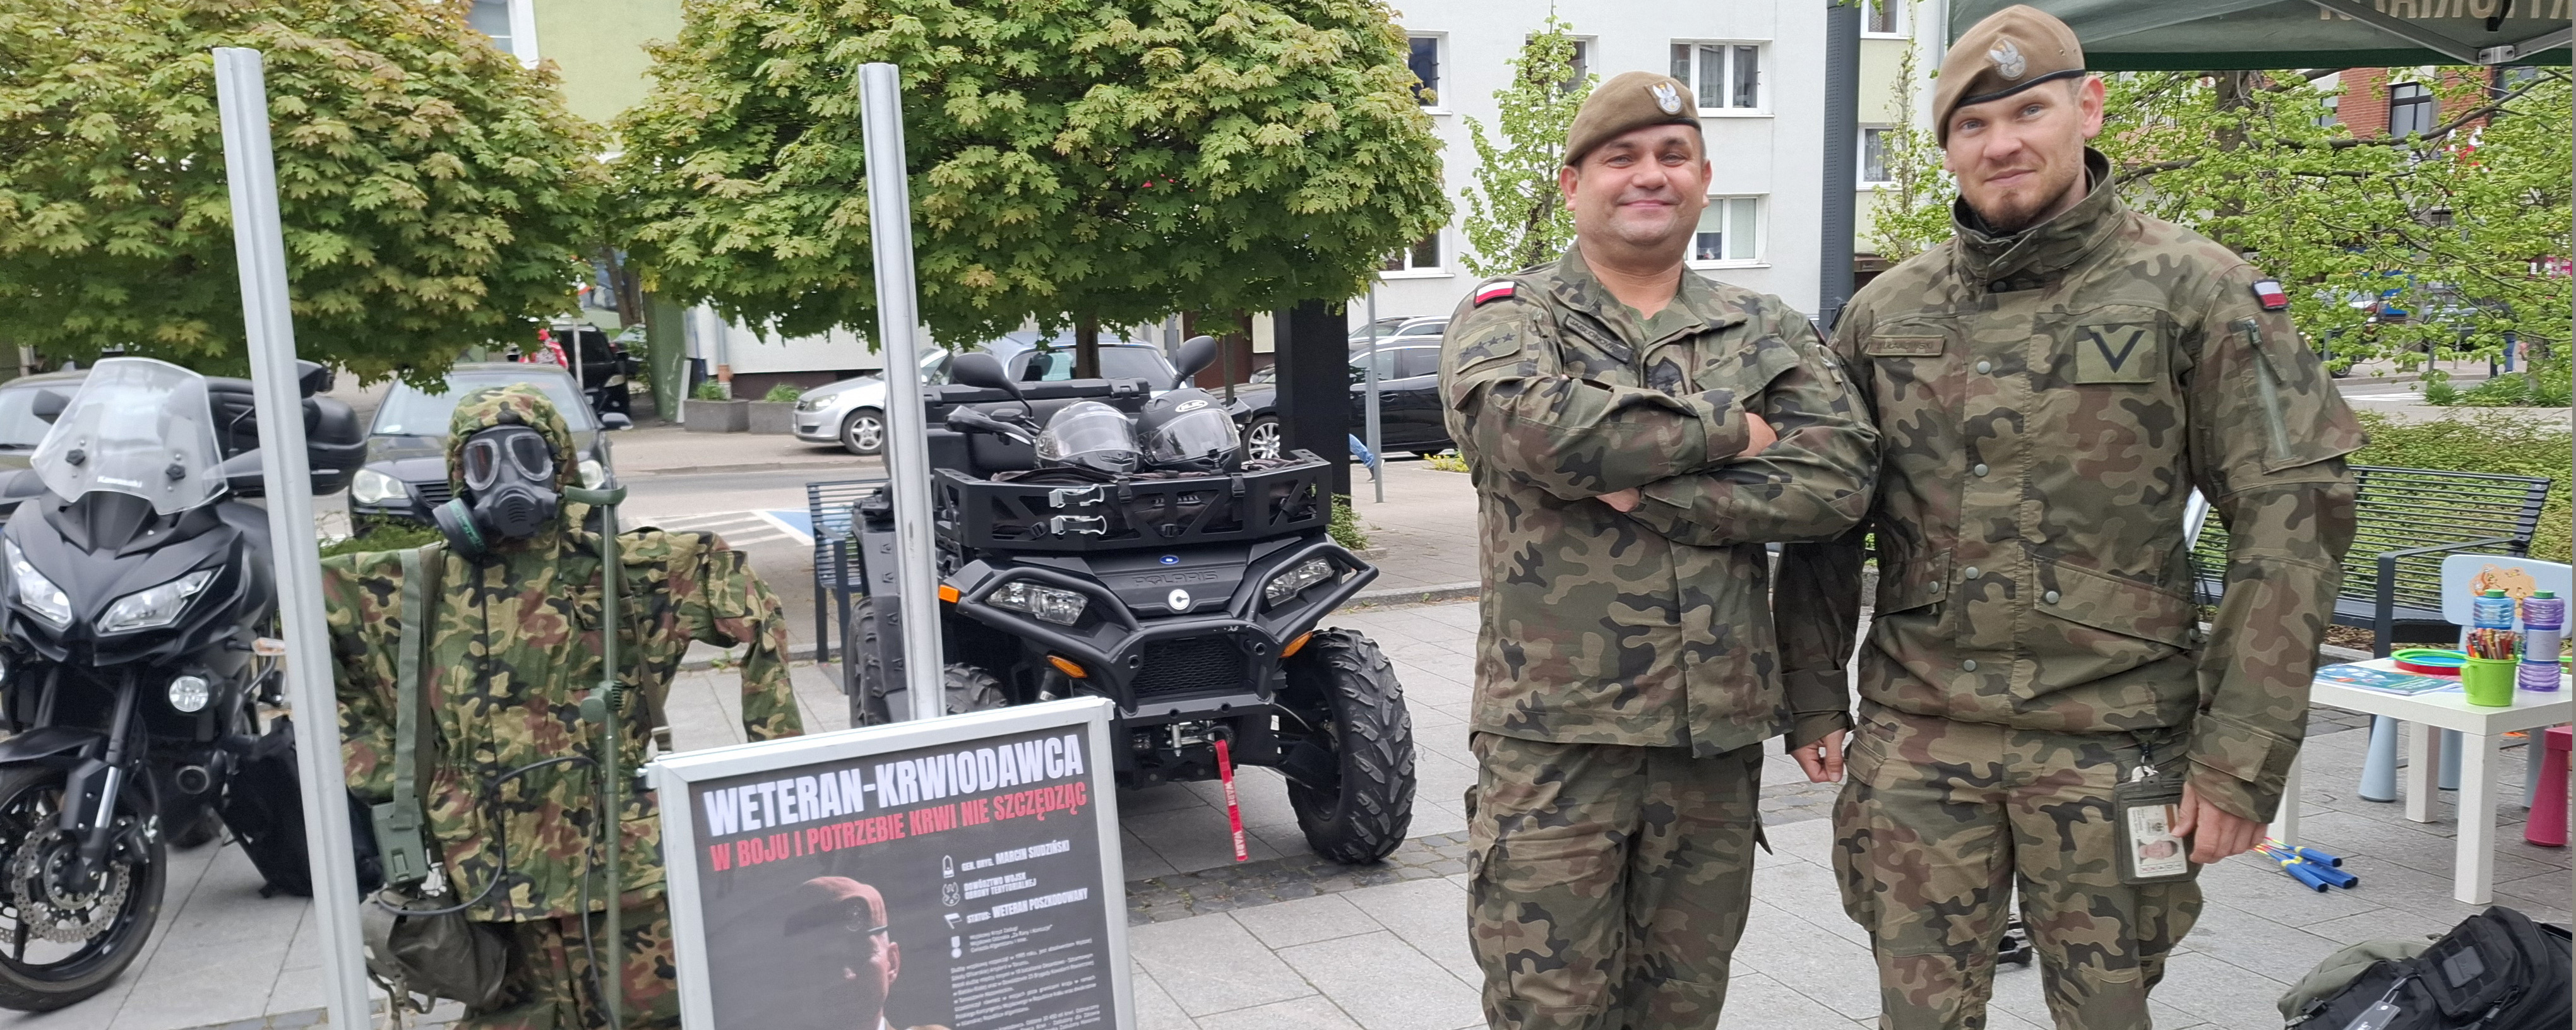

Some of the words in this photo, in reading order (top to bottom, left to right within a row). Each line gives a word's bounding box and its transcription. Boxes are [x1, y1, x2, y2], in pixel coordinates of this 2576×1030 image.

[1131, 571, 1219, 587] POLARIS
[703, 734, 1084, 838] WETERAN-KRWIODAWCA
[710, 843, 730, 872] W
[736, 832, 790, 867] BOJU
[794, 831, 803, 857] I
[806, 812, 906, 855] POTRZEBIE
[908, 803, 958, 836] KRWI
[960, 798, 991, 827] NIE
[993, 781, 1087, 822] SZCZĘDZĄC
[1225, 781, 1237, 806] WARN
[1233, 830, 1246, 857] WARN
[995, 848, 1028, 865] MARCIN
[991, 899, 1029, 918] WETERAN
[1029, 887, 1088, 911] POSZKODOWANY
